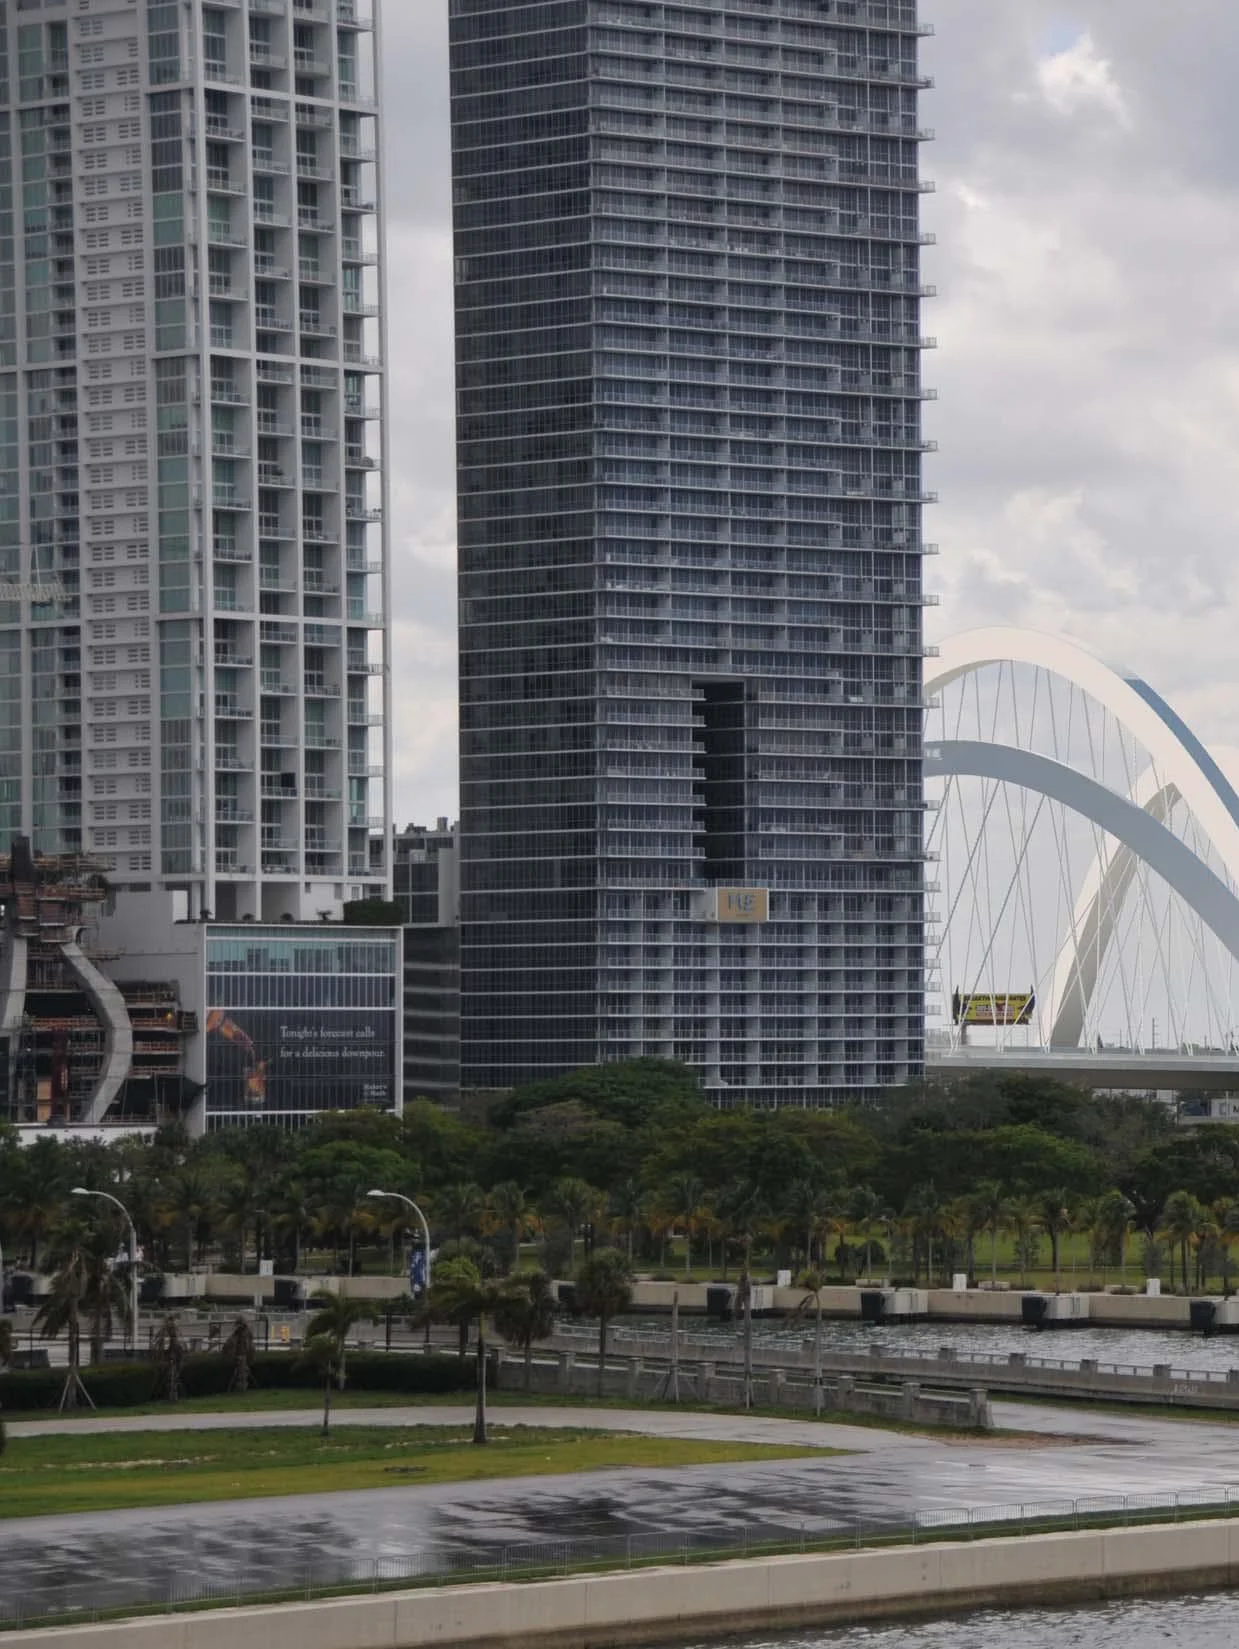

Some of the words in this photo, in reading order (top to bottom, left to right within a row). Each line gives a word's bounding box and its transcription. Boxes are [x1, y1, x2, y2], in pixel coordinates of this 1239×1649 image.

[280, 1026, 318, 1040] Tonight's
[320, 1026, 354, 1038] forecast
[355, 1026, 375, 1038] calls
[280, 1047, 293, 1057] for
[302, 1047, 339, 1057] delicious
